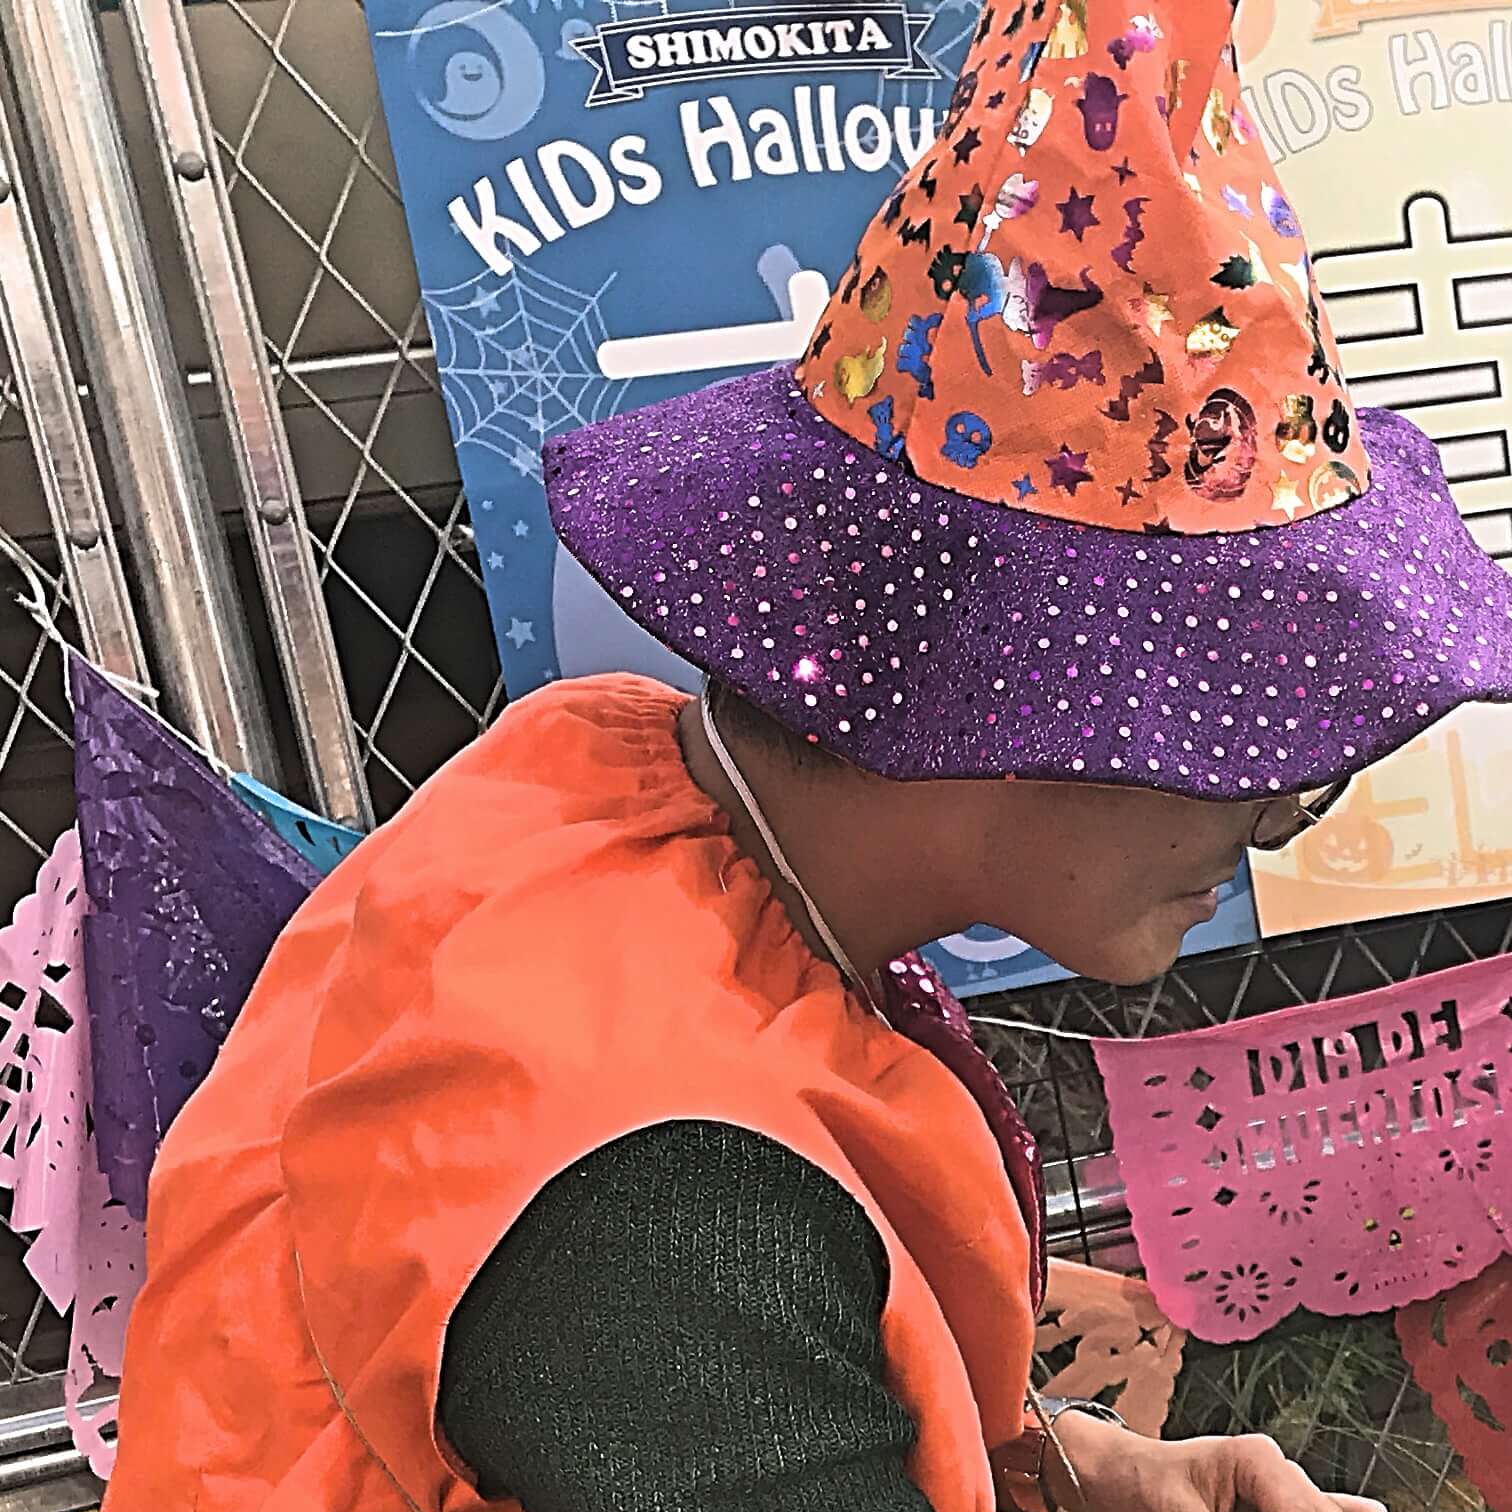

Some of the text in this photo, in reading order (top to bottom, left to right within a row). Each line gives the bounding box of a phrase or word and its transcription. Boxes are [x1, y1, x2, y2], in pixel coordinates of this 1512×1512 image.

[627, 17, 892, 69] SHIMOKITA
[1240, 65, 1373, 165] IDs
[447, 86, 950, 276] KIDs Hallow
[1380, 1000, 1461, 1070] DE
